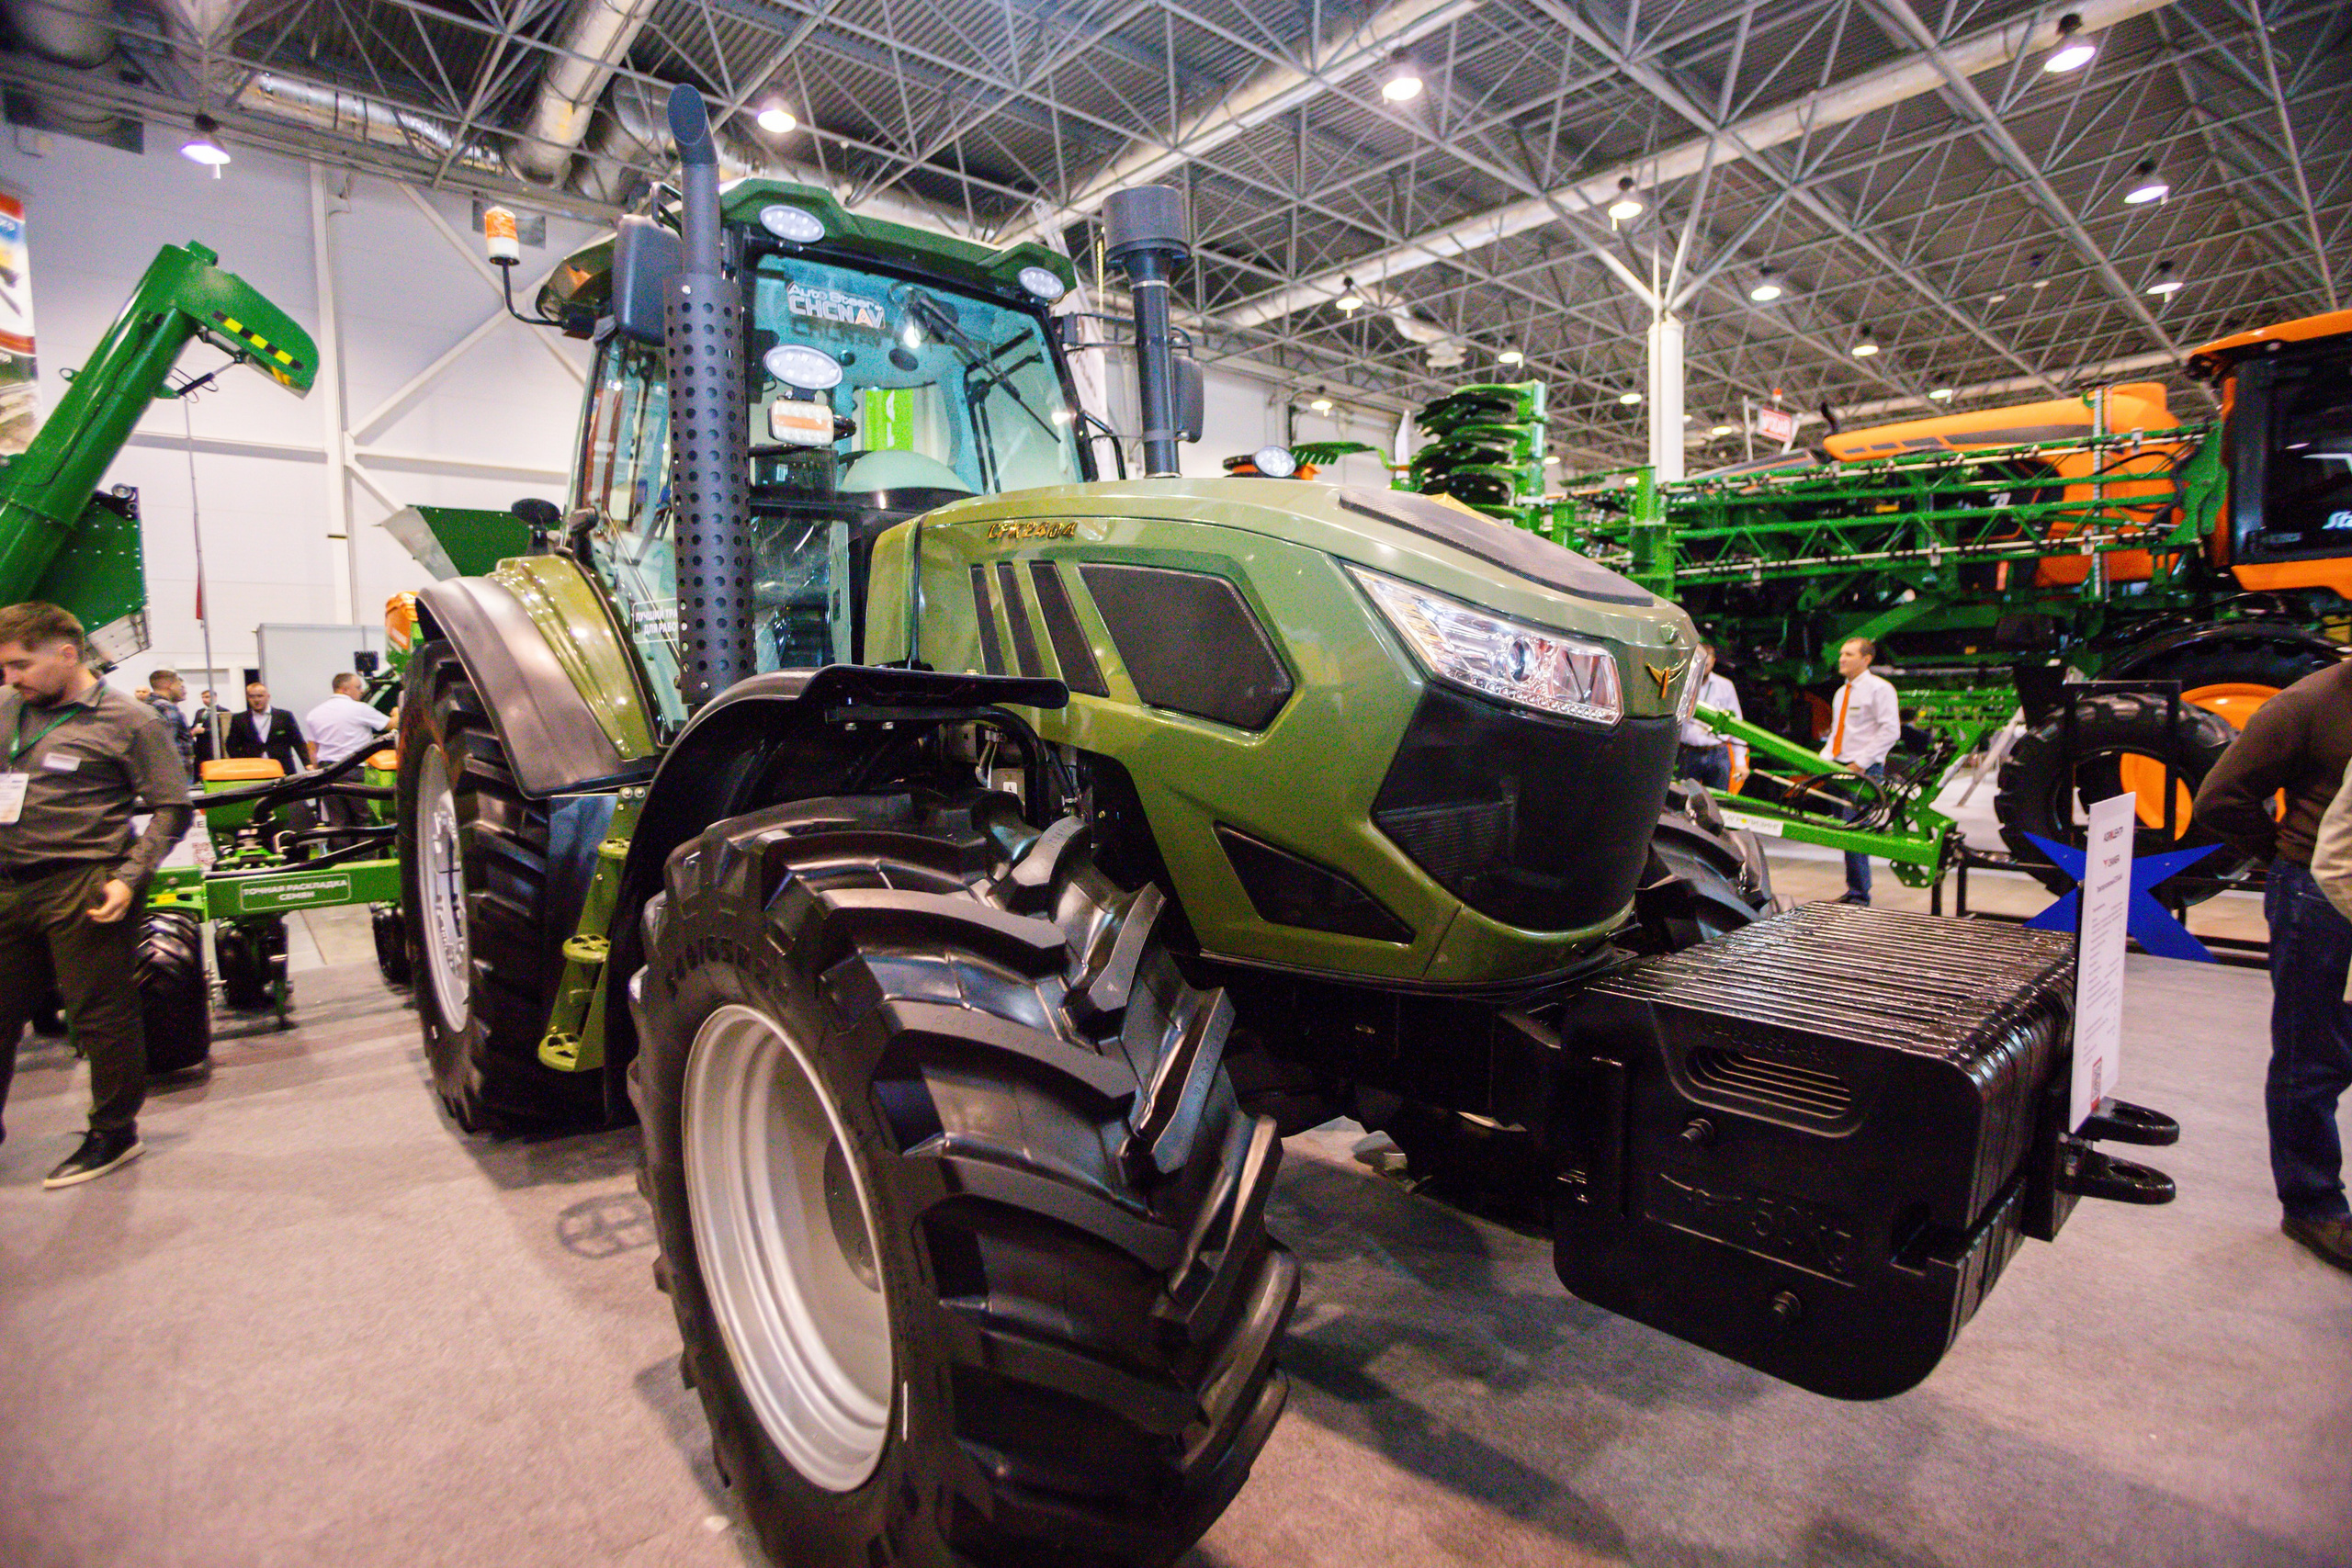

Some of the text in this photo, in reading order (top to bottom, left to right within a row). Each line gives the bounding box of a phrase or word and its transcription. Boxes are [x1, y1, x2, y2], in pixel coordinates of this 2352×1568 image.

[788, 284, 828, 300] Auto
[830, 291, 875, 309] Steer
[789, 294, 884, 329] CHCNAV
[635, 606, 678, 623] ЛУЧШИЙ ТРА
[644, 621, 678, 637] ДЛЯ РАБО
[243, 880, 348, 896] ТОЧНАЯ РАСКЛАДКА
[278, 891, 315, 901] СЕМЯН
